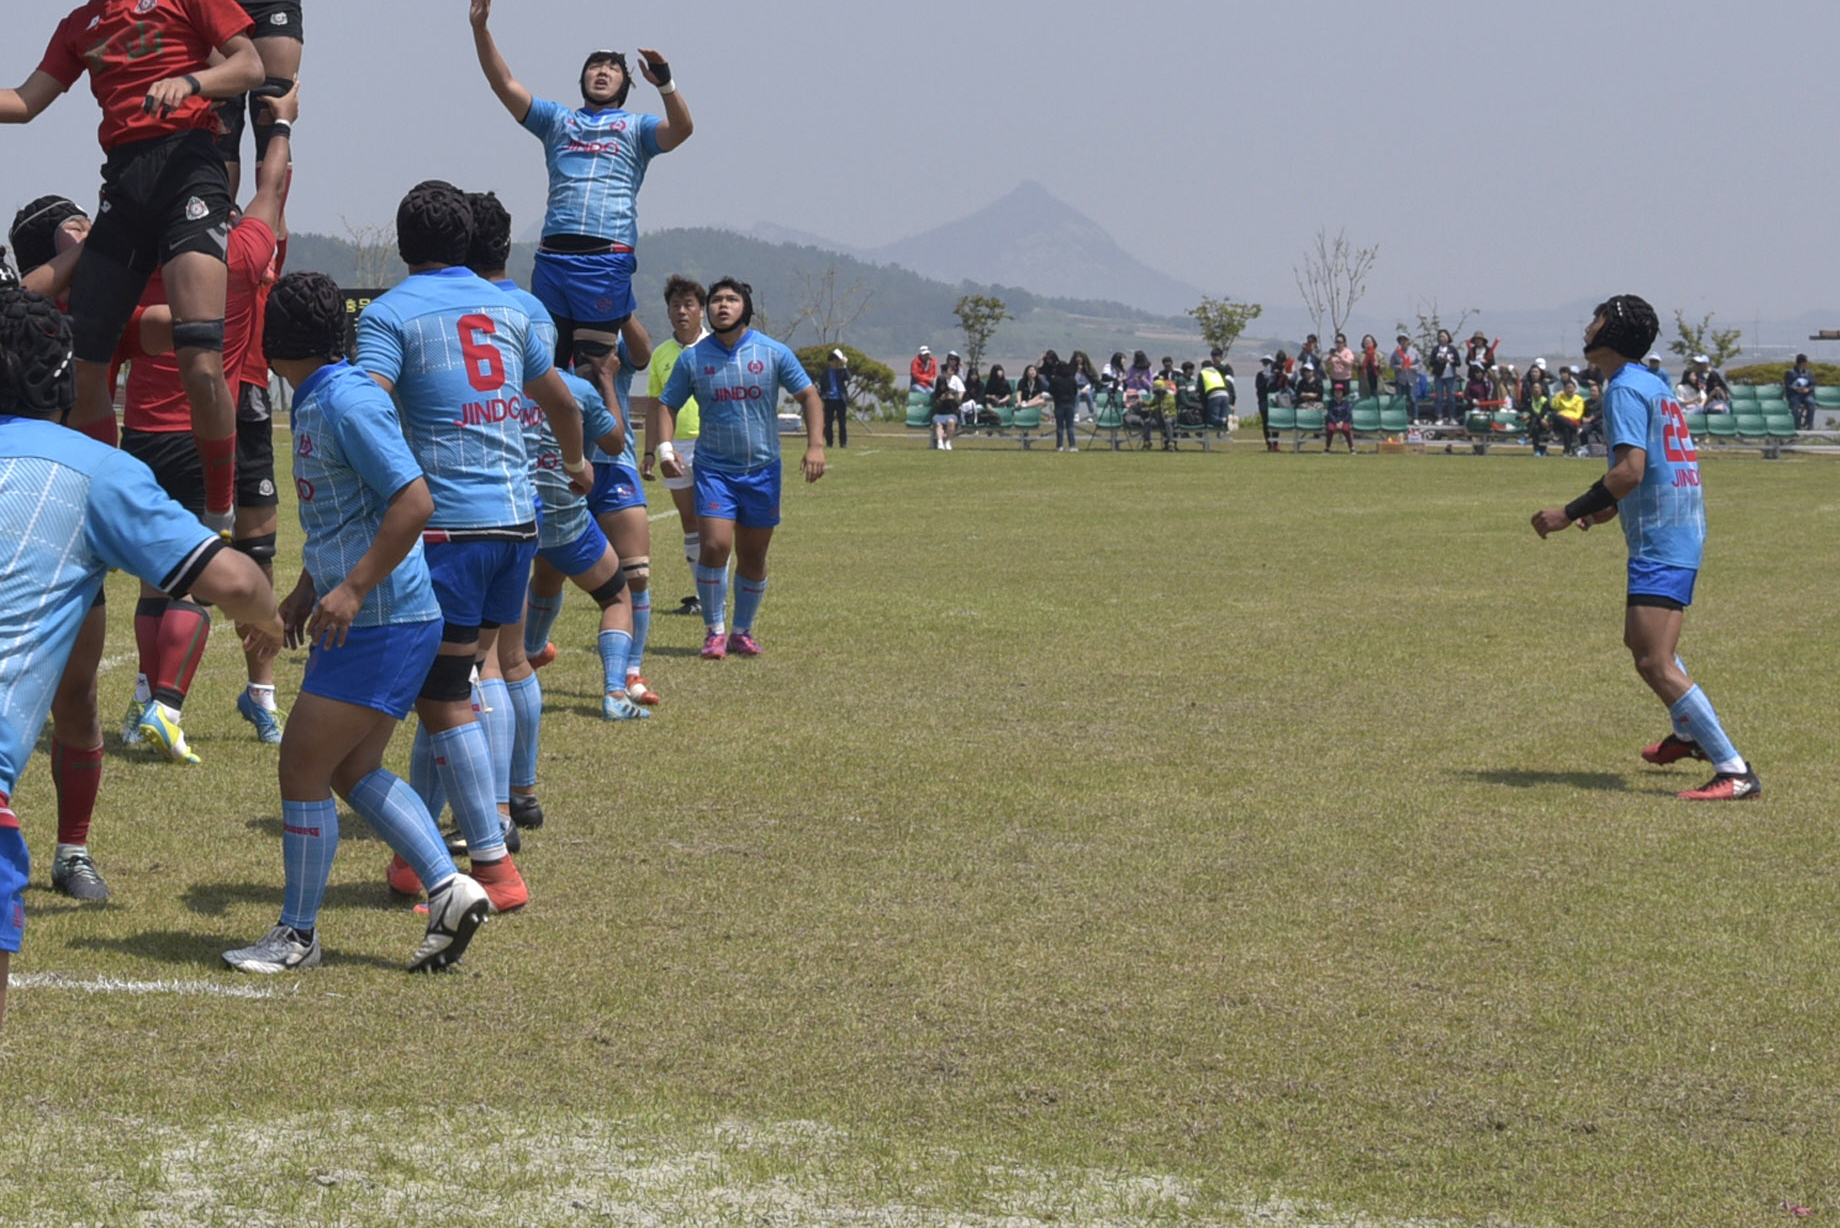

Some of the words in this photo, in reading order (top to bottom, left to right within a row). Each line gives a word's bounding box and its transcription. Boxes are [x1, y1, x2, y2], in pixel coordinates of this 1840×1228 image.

[562, 140, 619, 154] JINDO
[457, 314, 506, 392] 6
[712, 385, 762, 403] JINDO
[1661, 399, 1699, 462] 22
